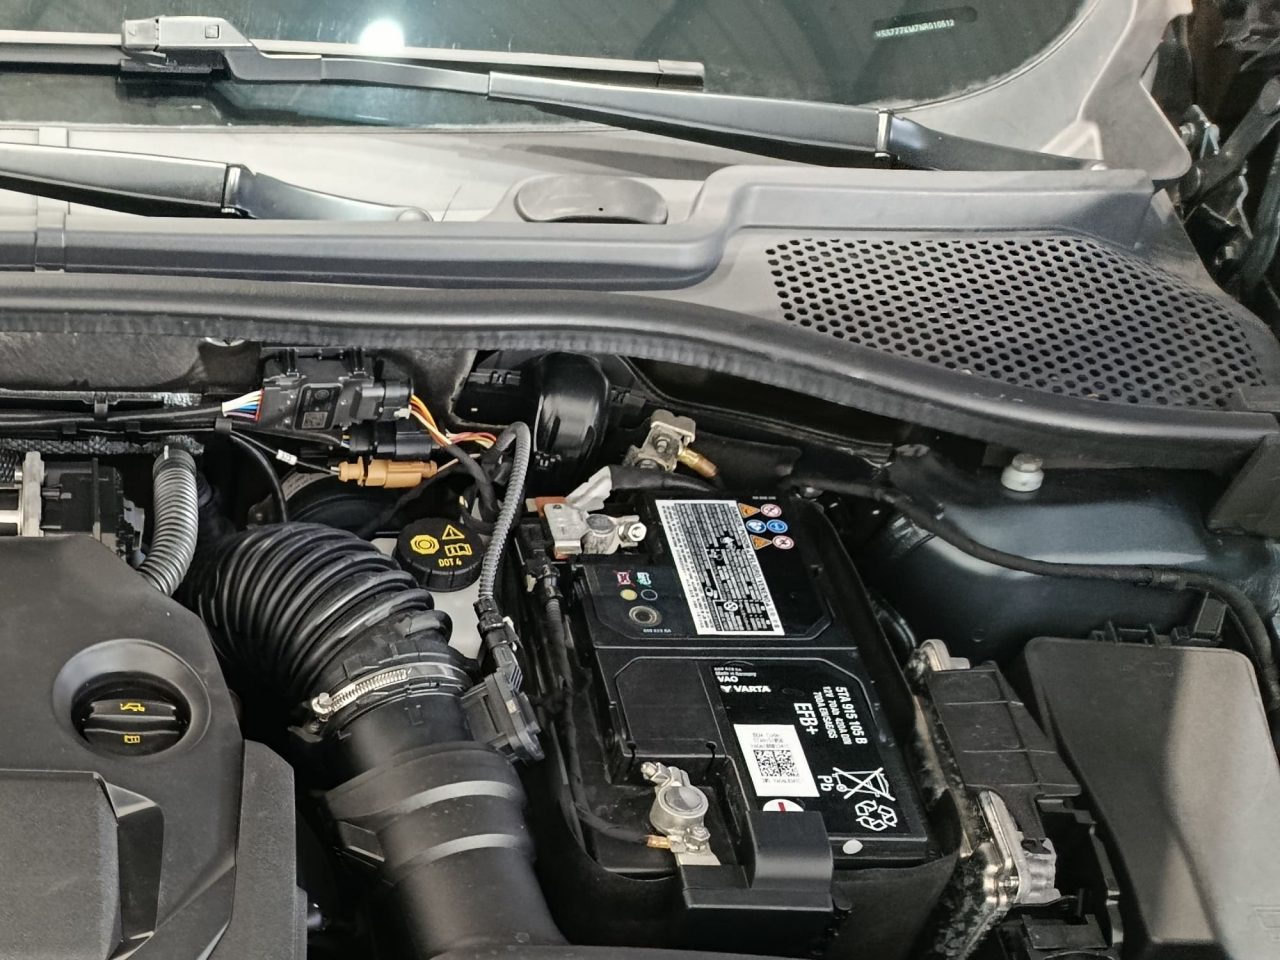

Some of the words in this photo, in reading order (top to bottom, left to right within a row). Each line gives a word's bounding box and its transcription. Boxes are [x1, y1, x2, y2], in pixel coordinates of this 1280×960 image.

[438, 558, 454, 567] DOT
[733, 684, 772, 693] VARTA
[822, 686, 835, 698] 12V
[835, 686, 852, 703] 5TA
[793, 702, 819, 735] EFB+
[841, 703, 859, 720] 915
[848, 720, 865, 737] 105
[854, 737, 869, 745] B
[817, 775, 835, 792] Pb
